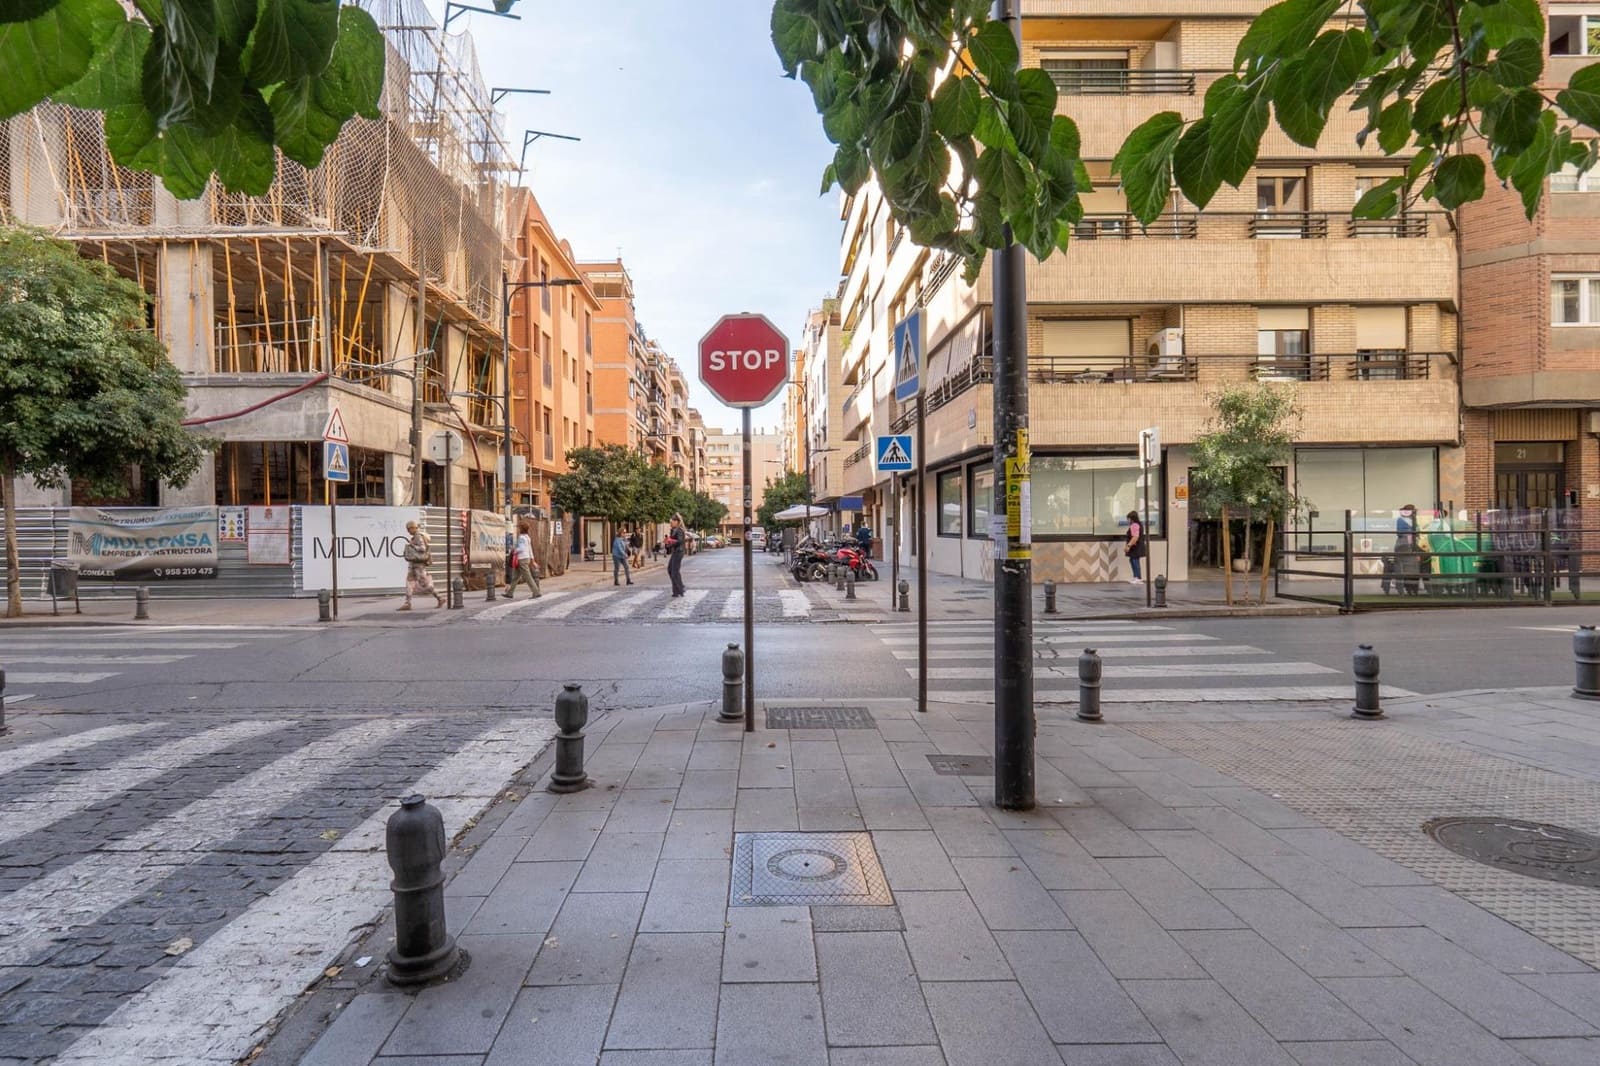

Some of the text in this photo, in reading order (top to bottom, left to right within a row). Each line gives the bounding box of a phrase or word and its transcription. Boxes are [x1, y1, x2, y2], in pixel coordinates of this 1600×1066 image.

[708, 349, 781, 371] STOP
[1516, 448, 1527, 459] 21
[102, 532, 212, 550] MULCONSA
[101, 549, 143, 558] EMPRESA
[165, 567, 214, 576] 958 210 475
